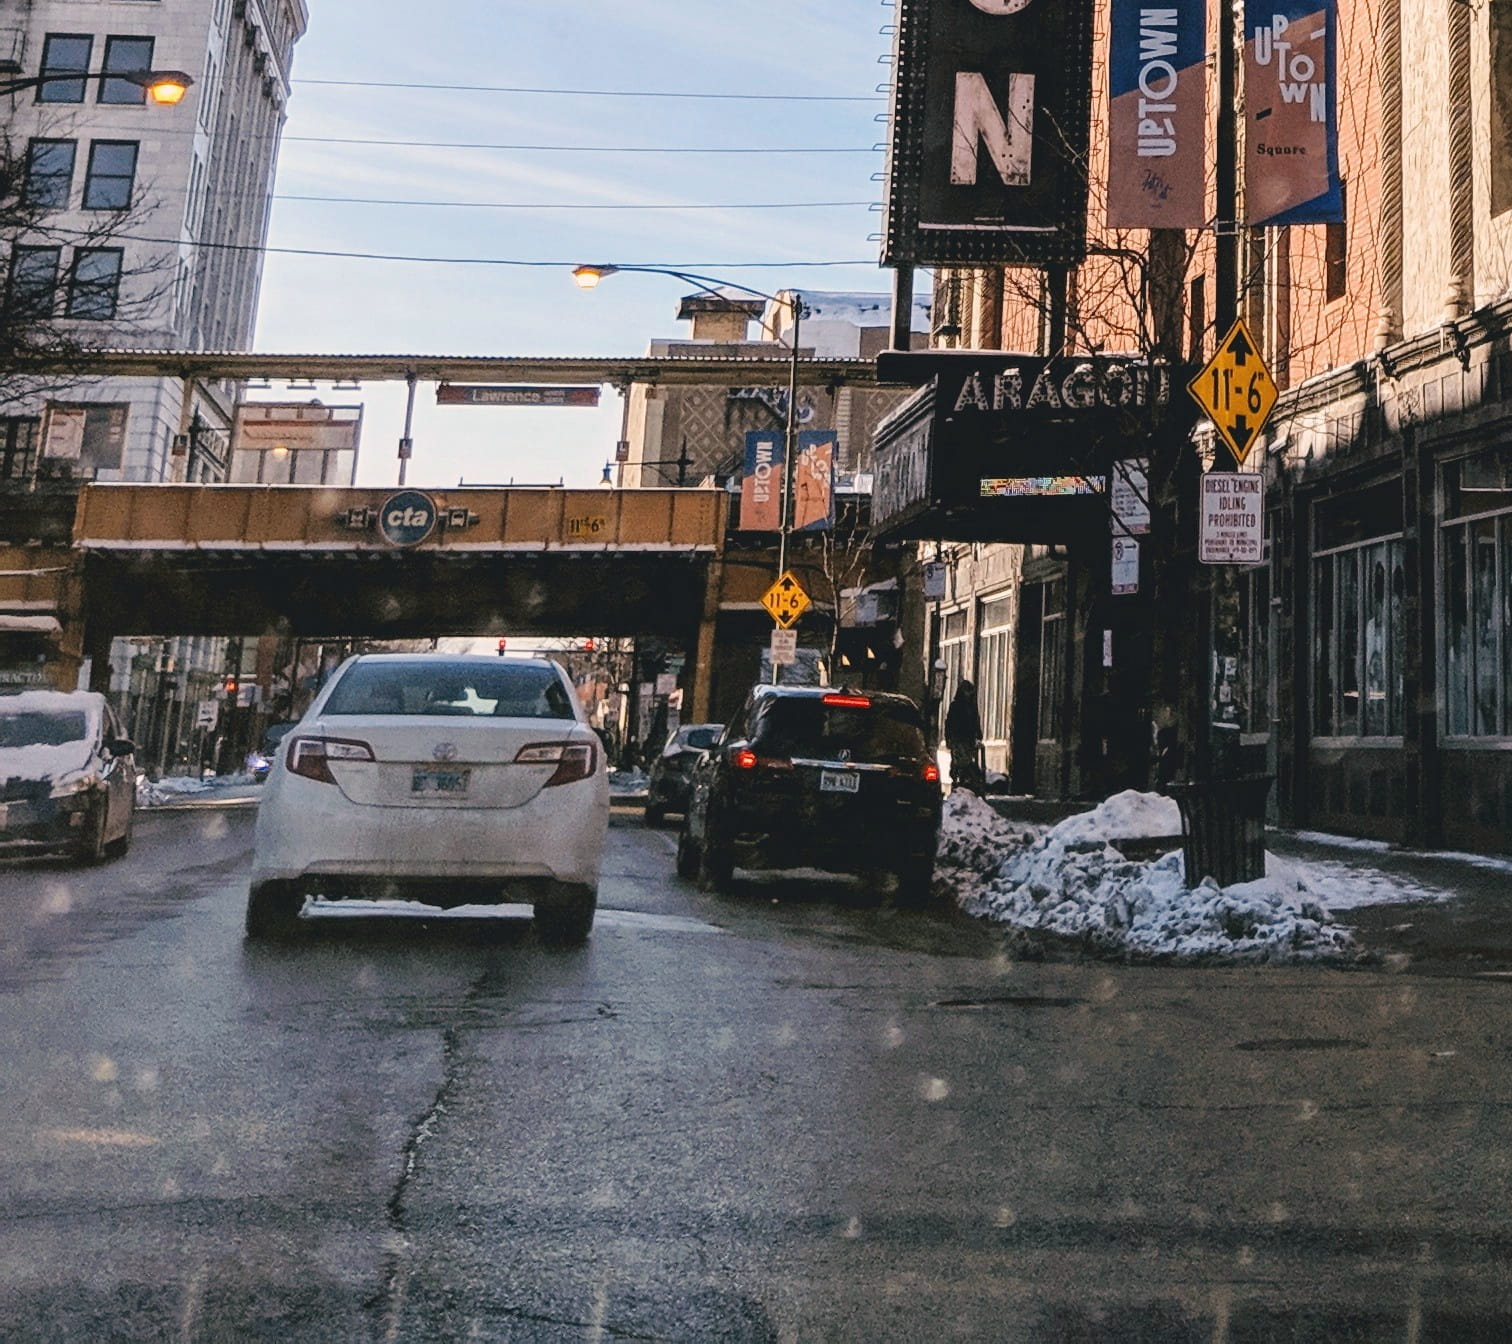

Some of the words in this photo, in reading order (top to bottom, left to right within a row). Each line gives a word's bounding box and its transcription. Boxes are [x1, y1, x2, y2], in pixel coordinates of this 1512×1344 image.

[1137, 8, 1178, 157] UPTOWN
[1256, 142, 1308, 158] Square
[472, 388, 541, 403] Lawrence
[954, 367, 1170, 412] ARAGON
[753, 441, 774, 504] UPTOWN
[1205, 479, 1230, 493] DIESEL
[1233, 479, 1260, 494] ENGINE
[1219, 496, 1246, 511] IDLING
[387, 507, 428, 528] cta
[1208, 513, 1257, 528] PROHIBITED
